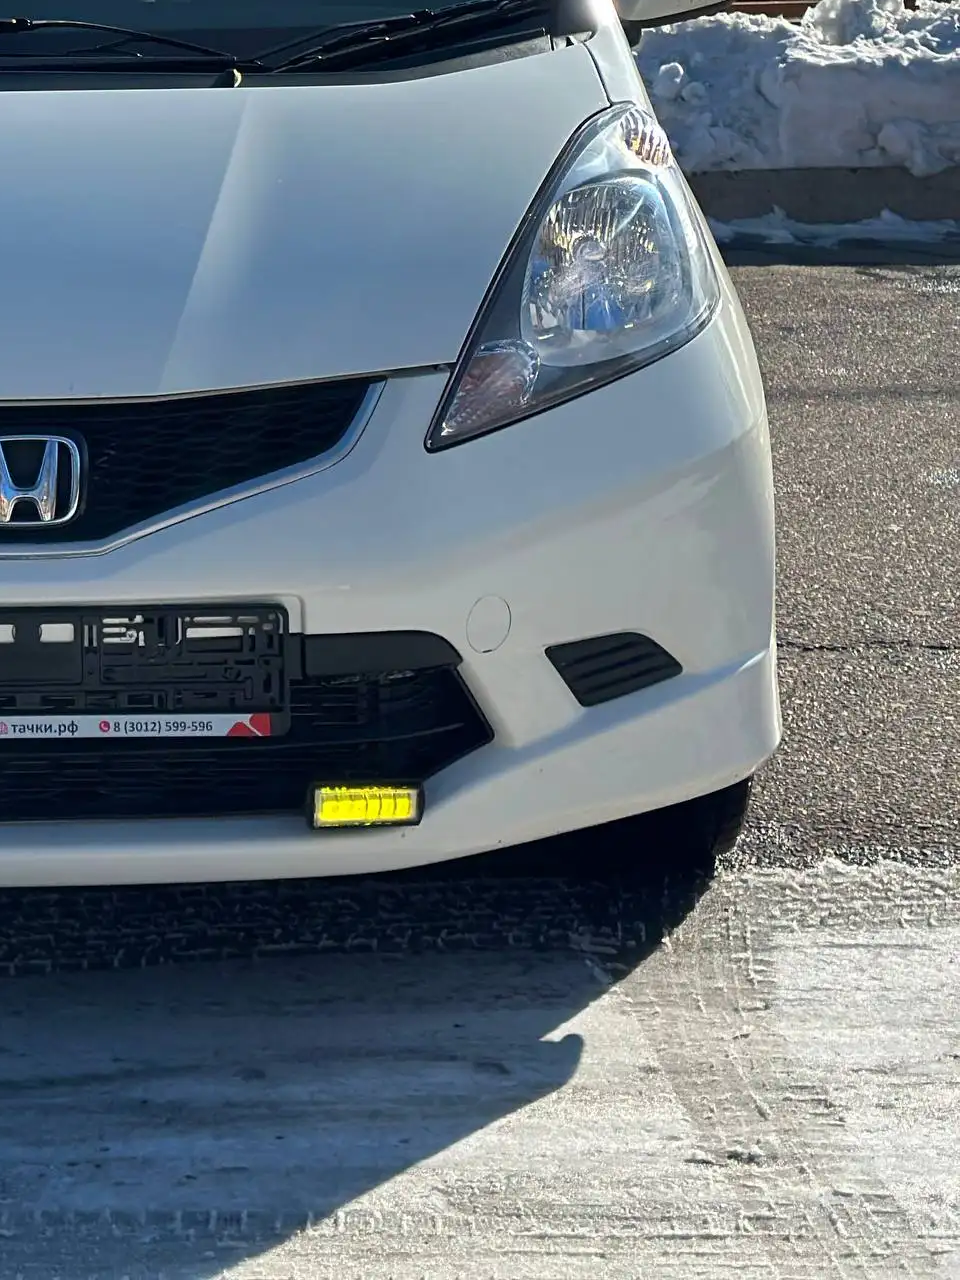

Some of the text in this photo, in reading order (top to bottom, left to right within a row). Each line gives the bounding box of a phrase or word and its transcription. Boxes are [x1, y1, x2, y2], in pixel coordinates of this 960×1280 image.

[11, 720, 79, 737] тачки.рф
[113, 721, 121, 733] 8
[123, 720, 162, 735] (3012)
[164, 720, 213, 733] 599-596
